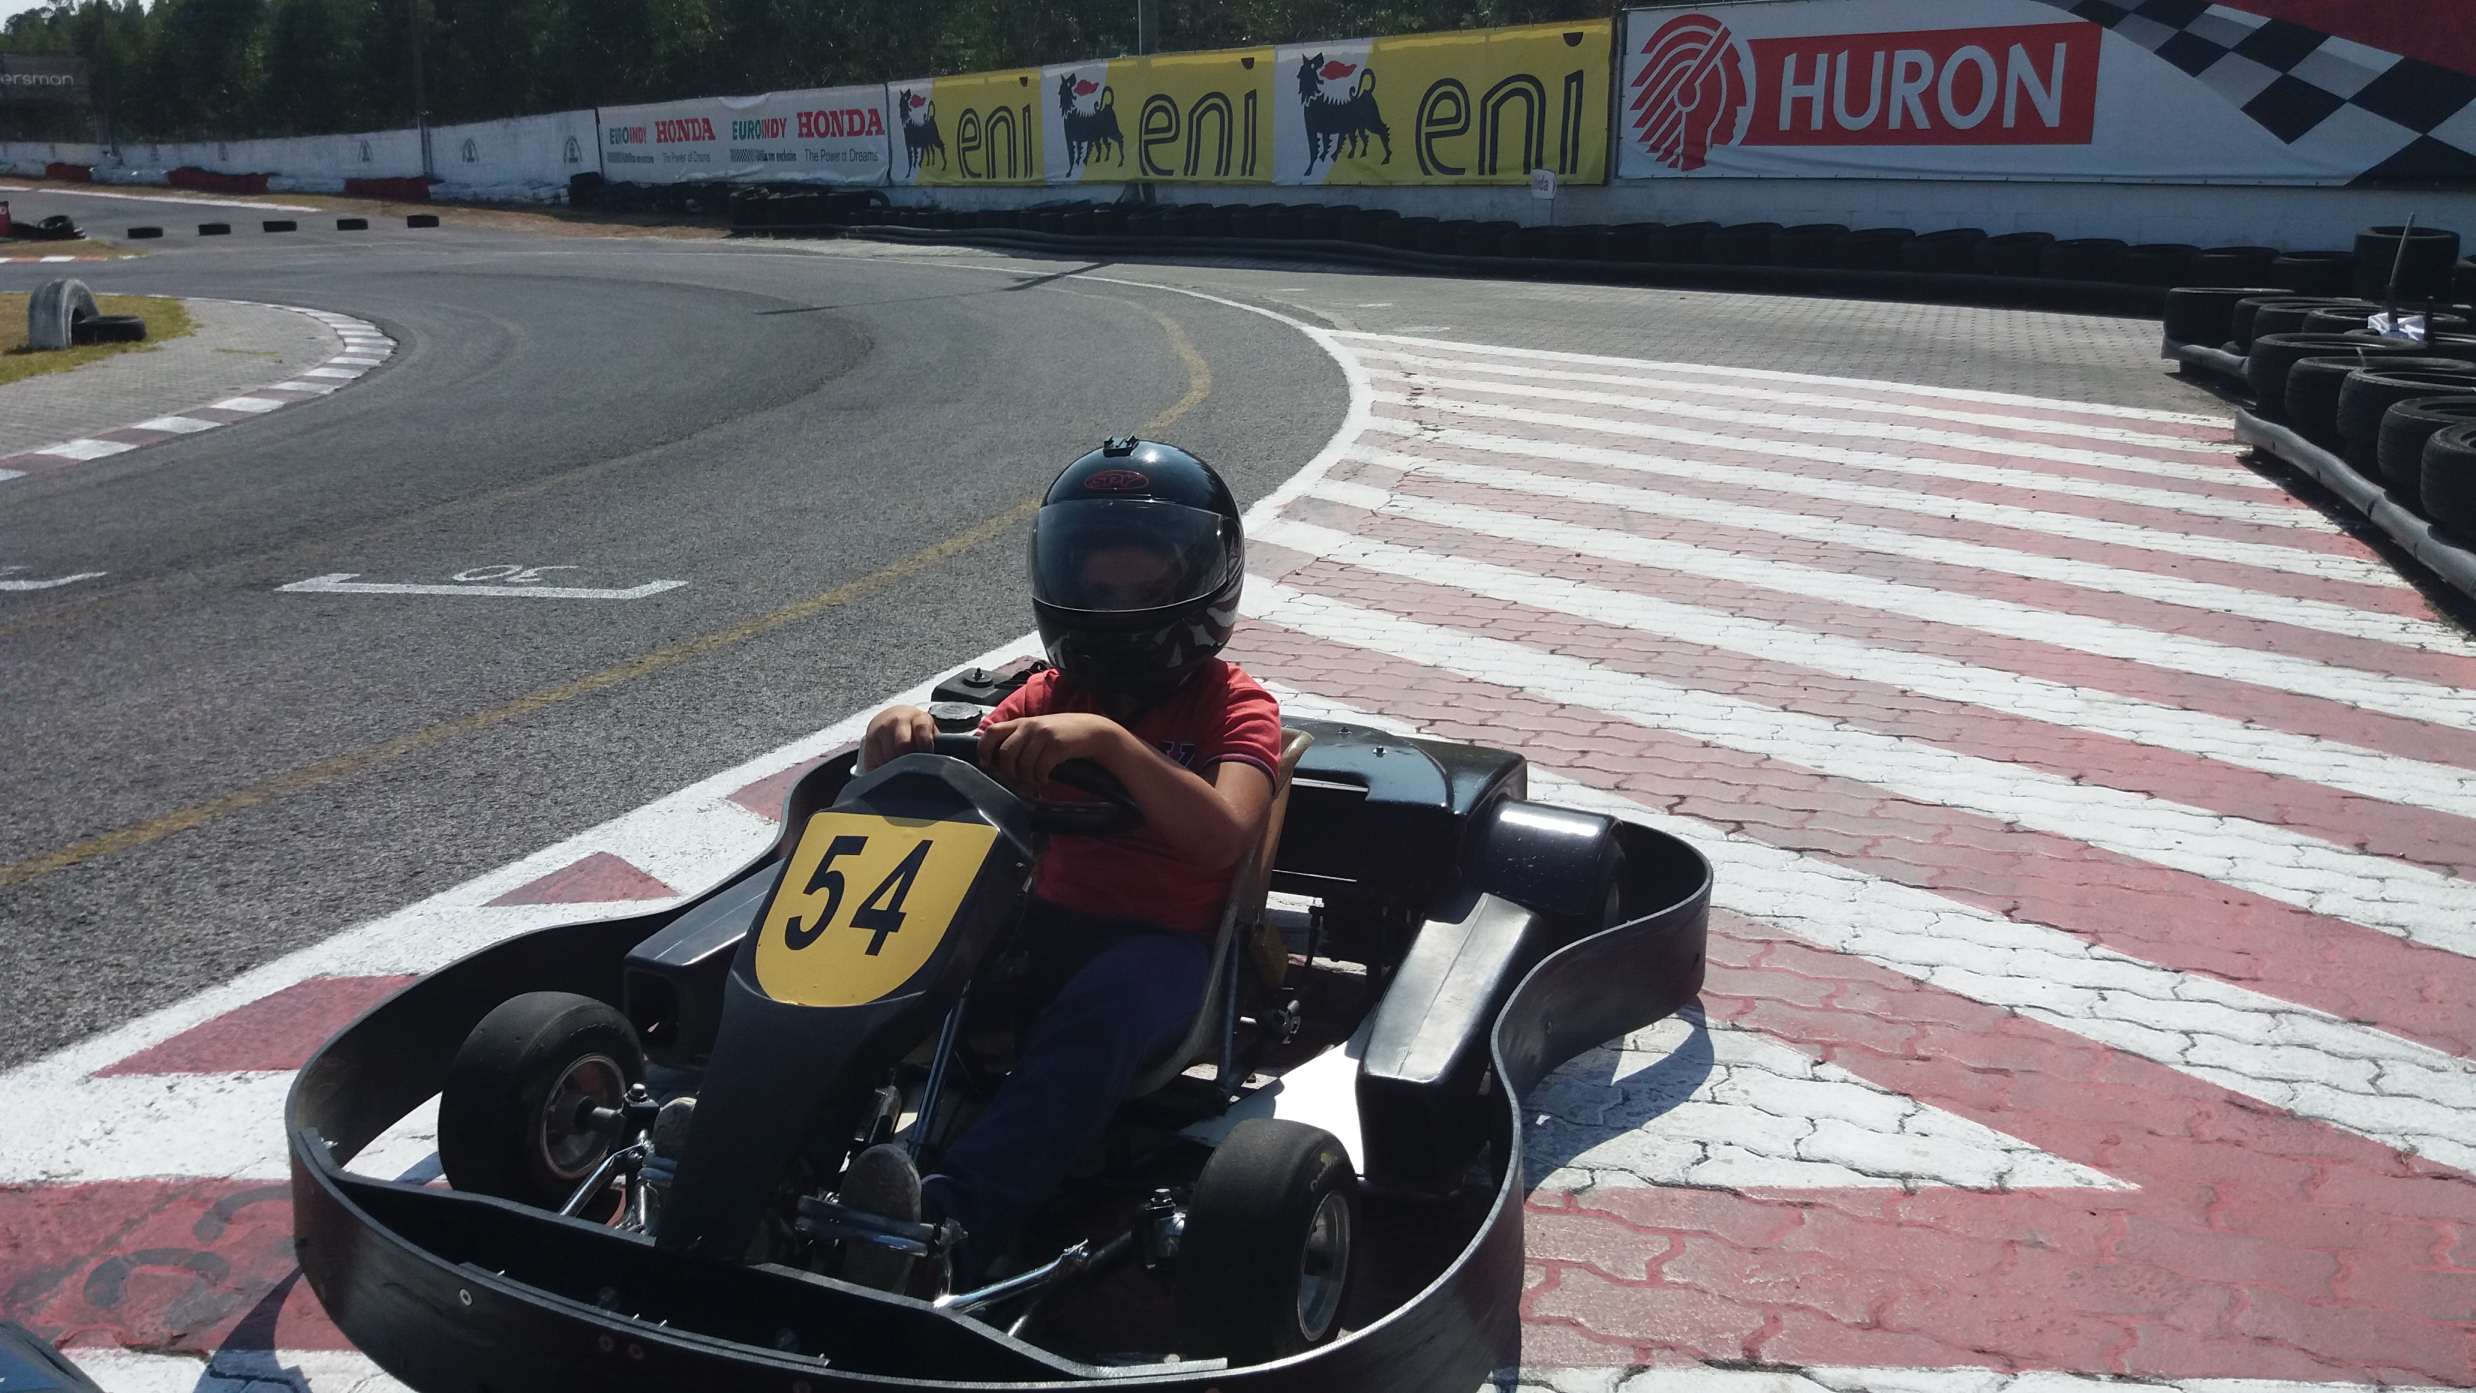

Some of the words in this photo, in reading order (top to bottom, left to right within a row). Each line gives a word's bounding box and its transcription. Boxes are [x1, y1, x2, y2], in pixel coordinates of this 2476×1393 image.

[797, 108, 885, 138] HONDA
[1416, 69, 1585, 177] eni
[1778, 41, 2067, 132] HURON
[609, 127, 647, 144] EUROINDY
[655, 117, 716, 143] HONDA
[732, 118, 787, 141] EUROINDY
[956, 104, 1033, 179] eni
[1139, 88, 1258, 177] eni
[784, 835, 934, 957] 54
